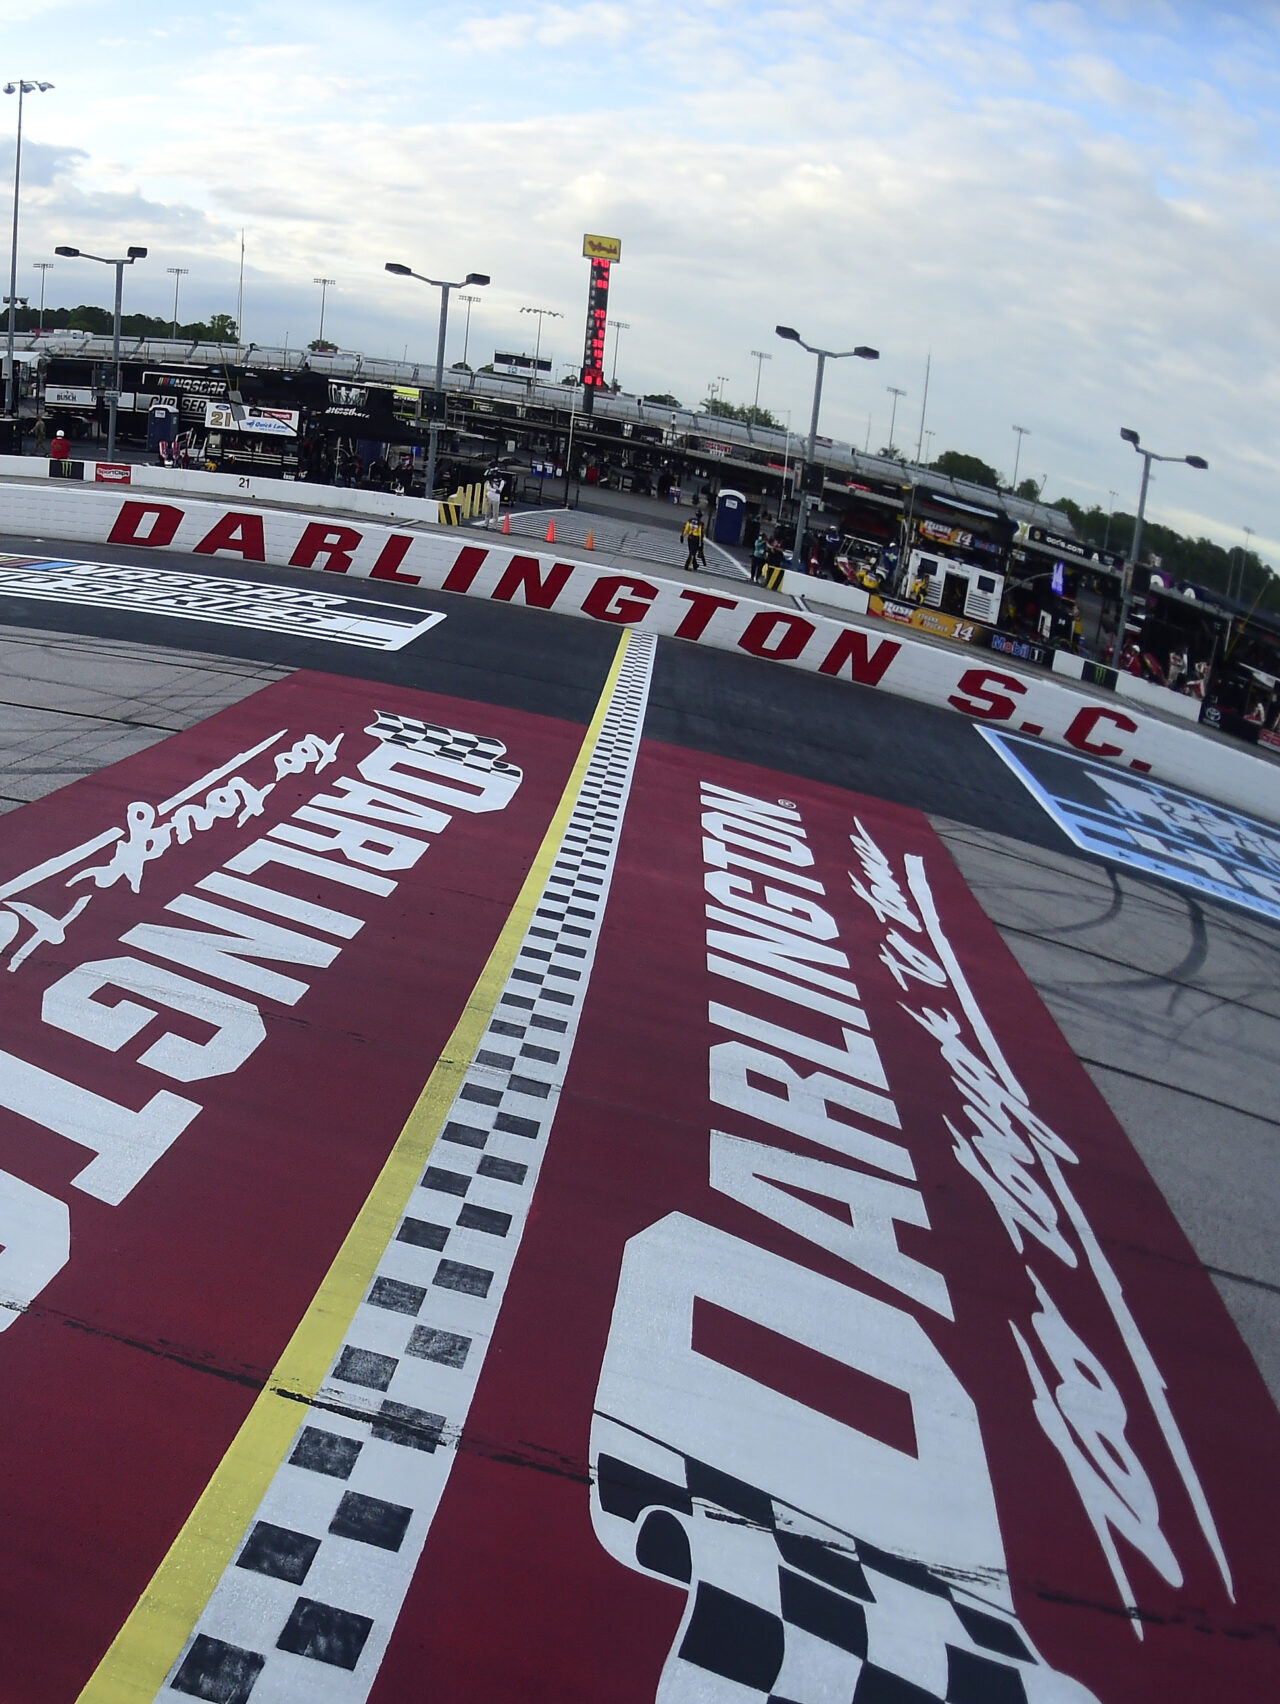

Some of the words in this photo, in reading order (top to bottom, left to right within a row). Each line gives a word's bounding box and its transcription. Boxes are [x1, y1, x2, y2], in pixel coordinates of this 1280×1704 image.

[174, 379, 227, 395] NASCAR
[57, 393, 77, 402] BUSCH
[182, 399, 207, 413] SER
[210, 411, 232, 428] 21
[255, 420, 272, 428] Quick
[238, 477, 250, 489] 21
[954, 530, 972, 546] 14
[53, 563, 350, 608] NASCAR
[70, 582, 338, 626] SERIES
[883, 600, 915, 617] RUSH
[107, 500, 902, 687] DARLINGTON
[946, 669, 1153, 774] S.C.
[950, 620, 975, 642] 14
[991, 633, 1030, 660] Mobil
[589, 781, 1020, 1640] DARLINGTON
